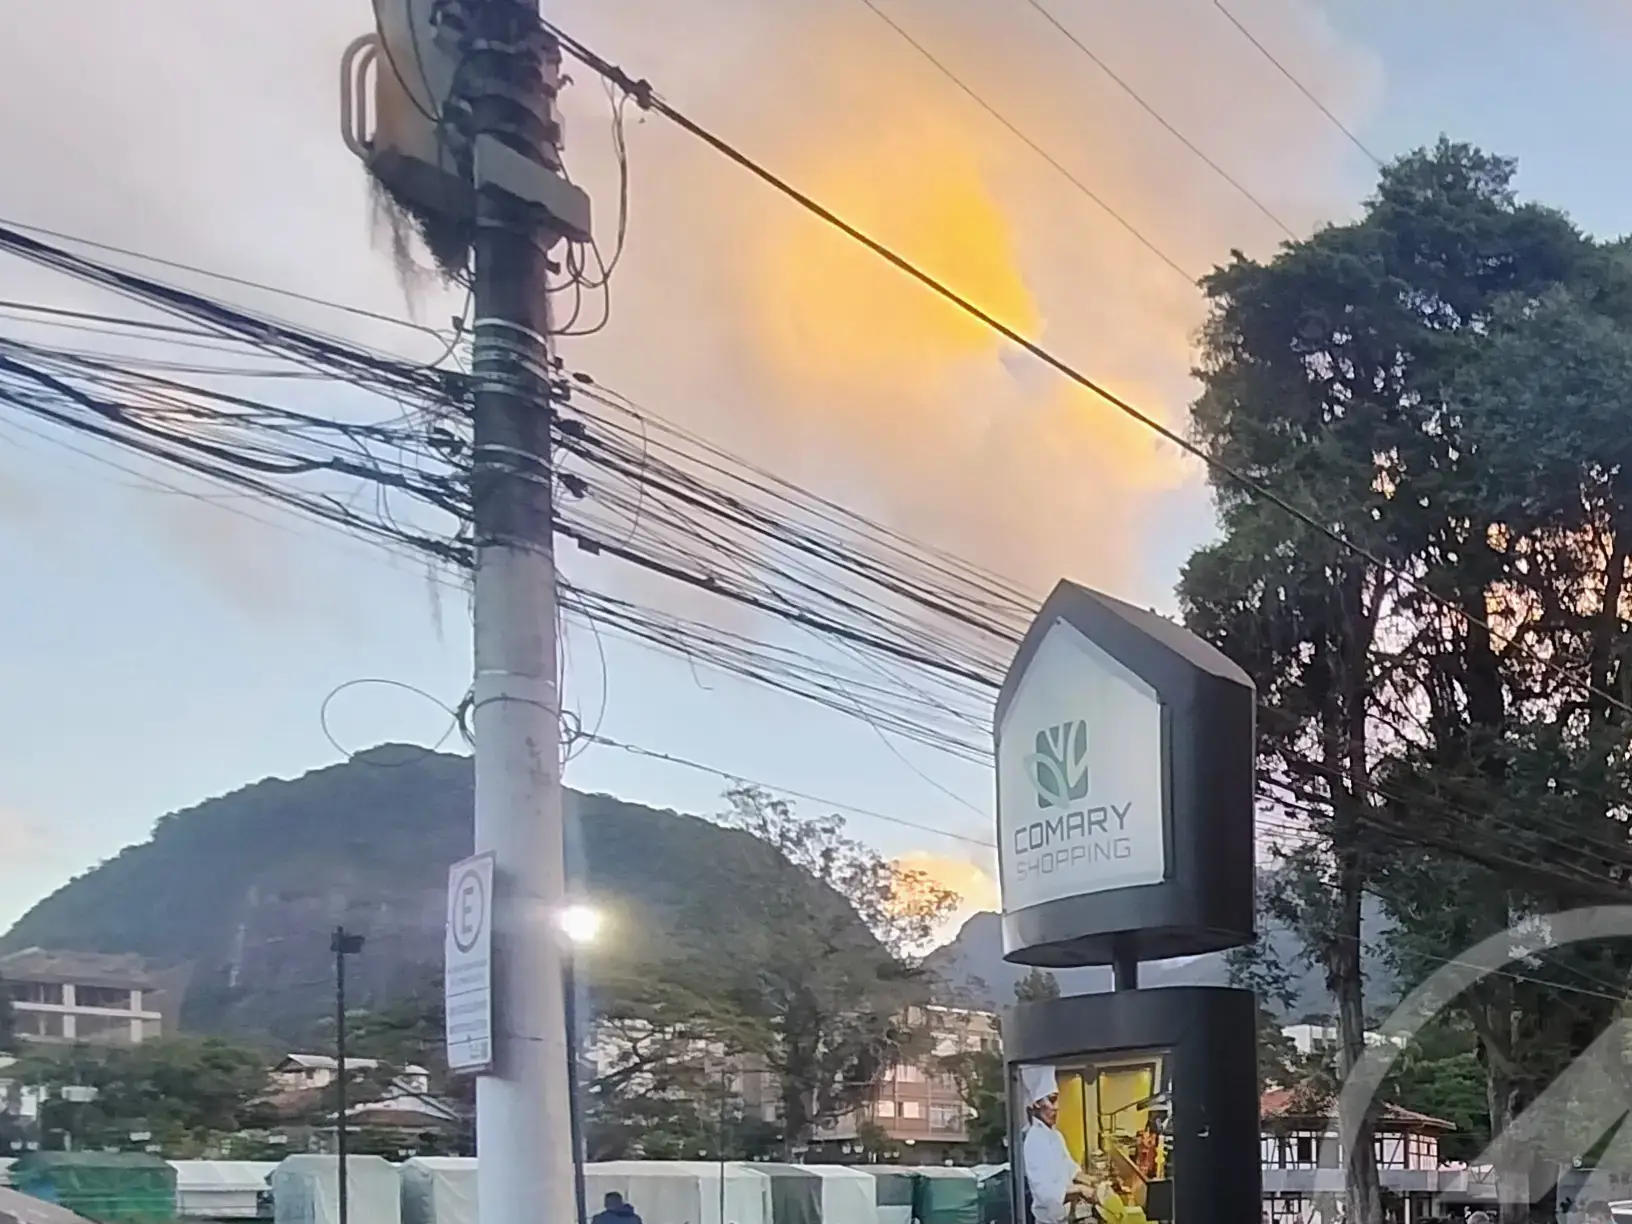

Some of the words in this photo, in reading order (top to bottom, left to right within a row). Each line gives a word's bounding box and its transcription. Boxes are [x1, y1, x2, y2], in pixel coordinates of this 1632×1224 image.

[1014, 801, 1132, 855] COMARY
[1016, 837, 1132, 882] SHOPPING
[462, 886, 474, 935] E
